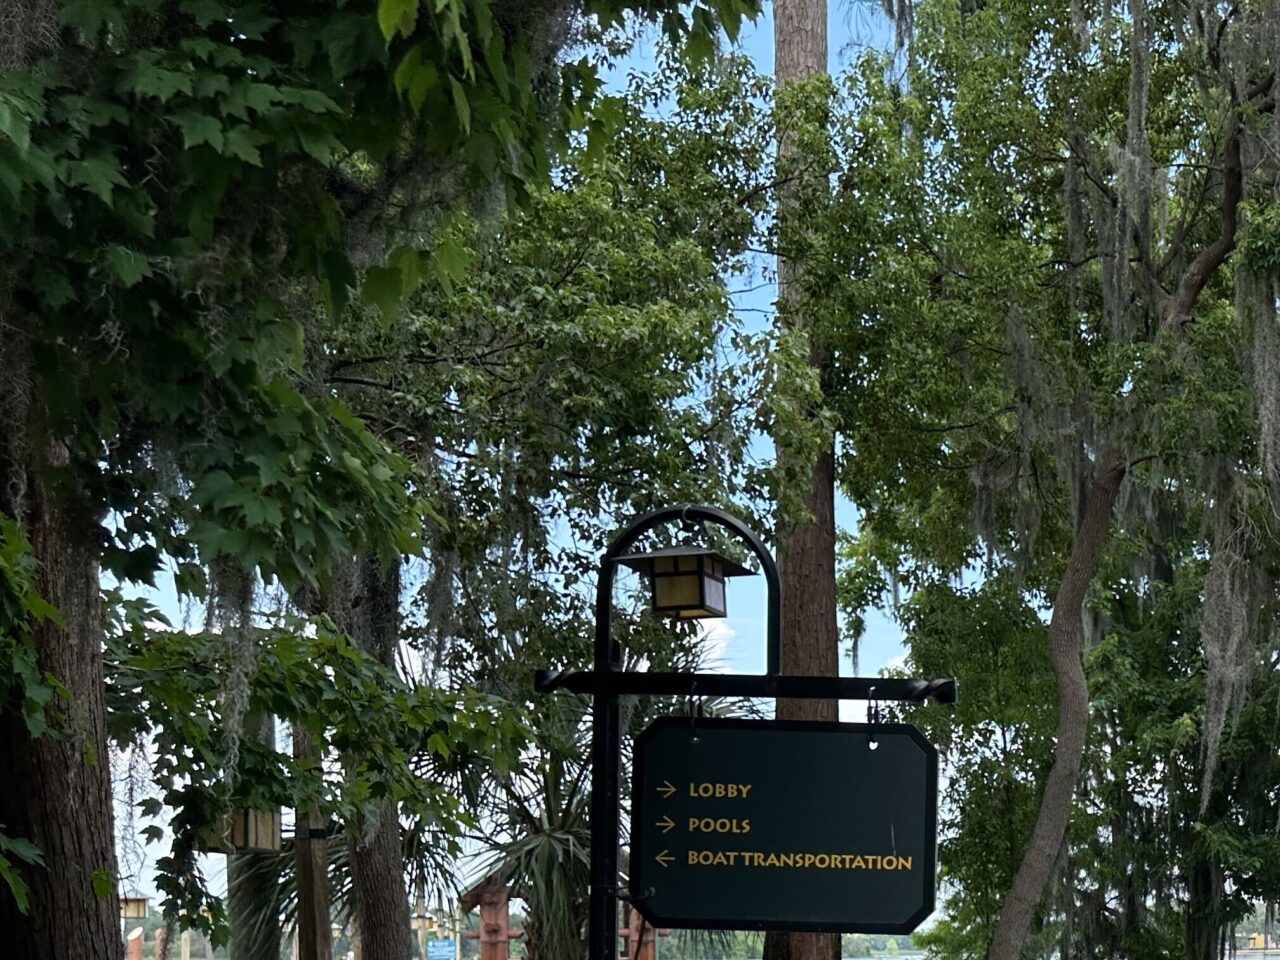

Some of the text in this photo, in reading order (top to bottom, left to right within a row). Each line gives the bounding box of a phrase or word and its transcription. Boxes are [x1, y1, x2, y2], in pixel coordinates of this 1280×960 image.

[689, 783, 752, 798] LOBBY
[688, 818, 751, 833] POOLS
[688, 850, 913, 870] BOAT TRANSPORTATION
